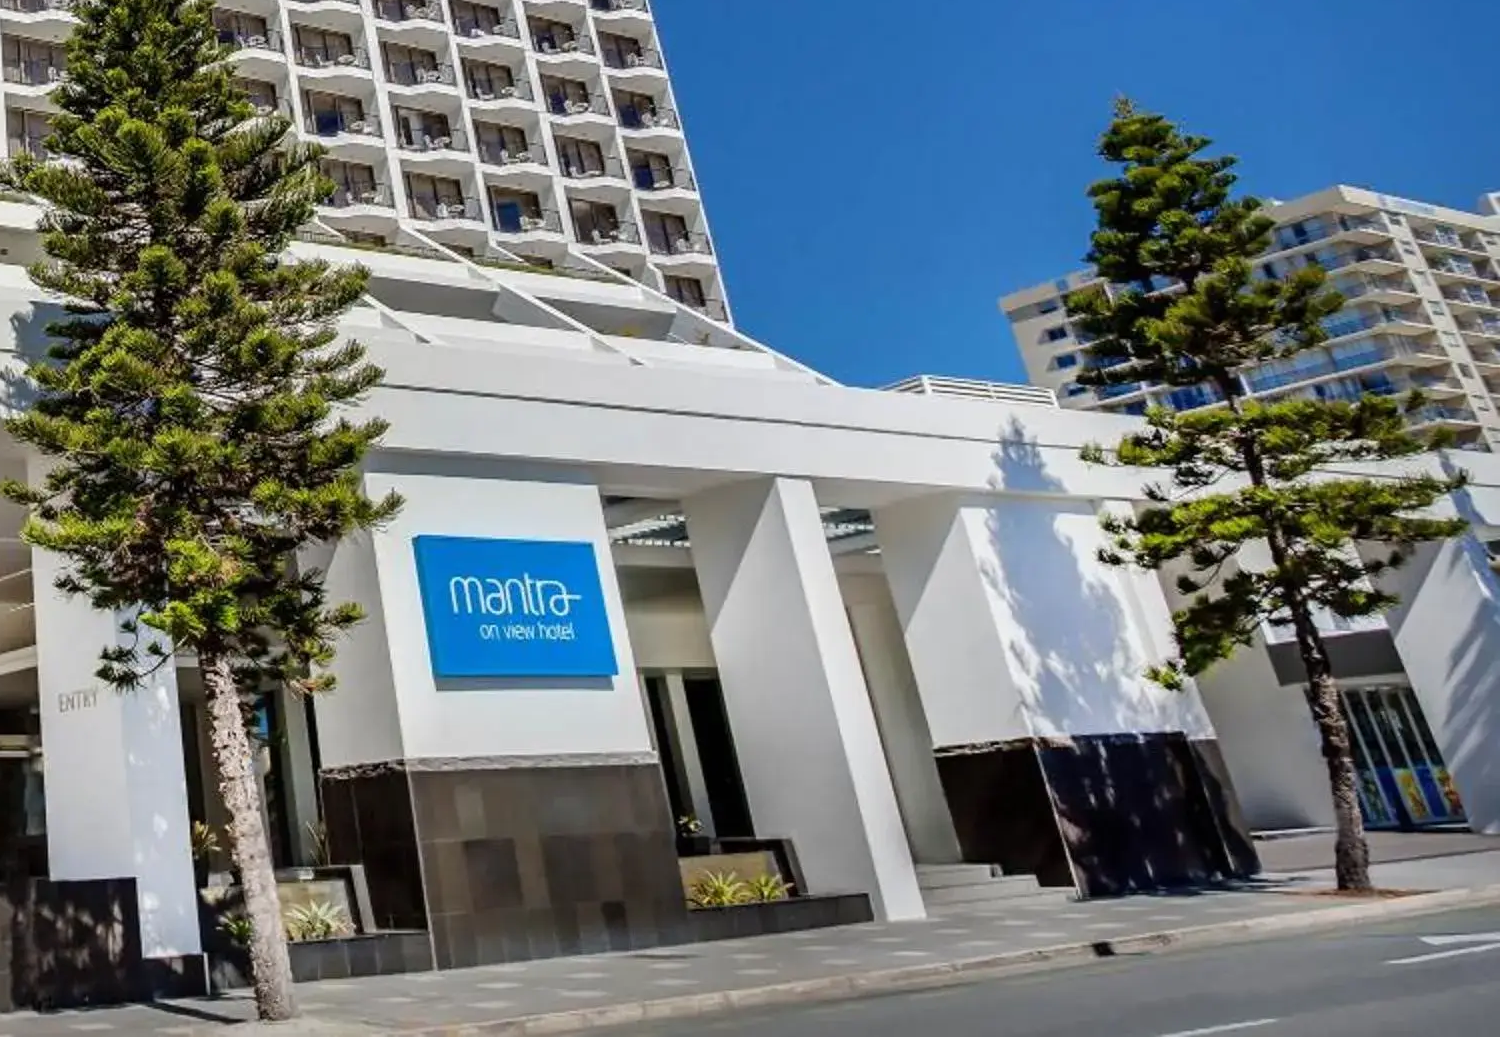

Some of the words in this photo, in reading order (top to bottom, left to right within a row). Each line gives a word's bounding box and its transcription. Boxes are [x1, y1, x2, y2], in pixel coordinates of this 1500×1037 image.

[450, 573, 581, 616] mantra
[480, 624, 500, 640] on
[504, 622, 535, 640] view
[538, 621, 575, 640] hotel
[59, 689, 98, 713] ENTRY
